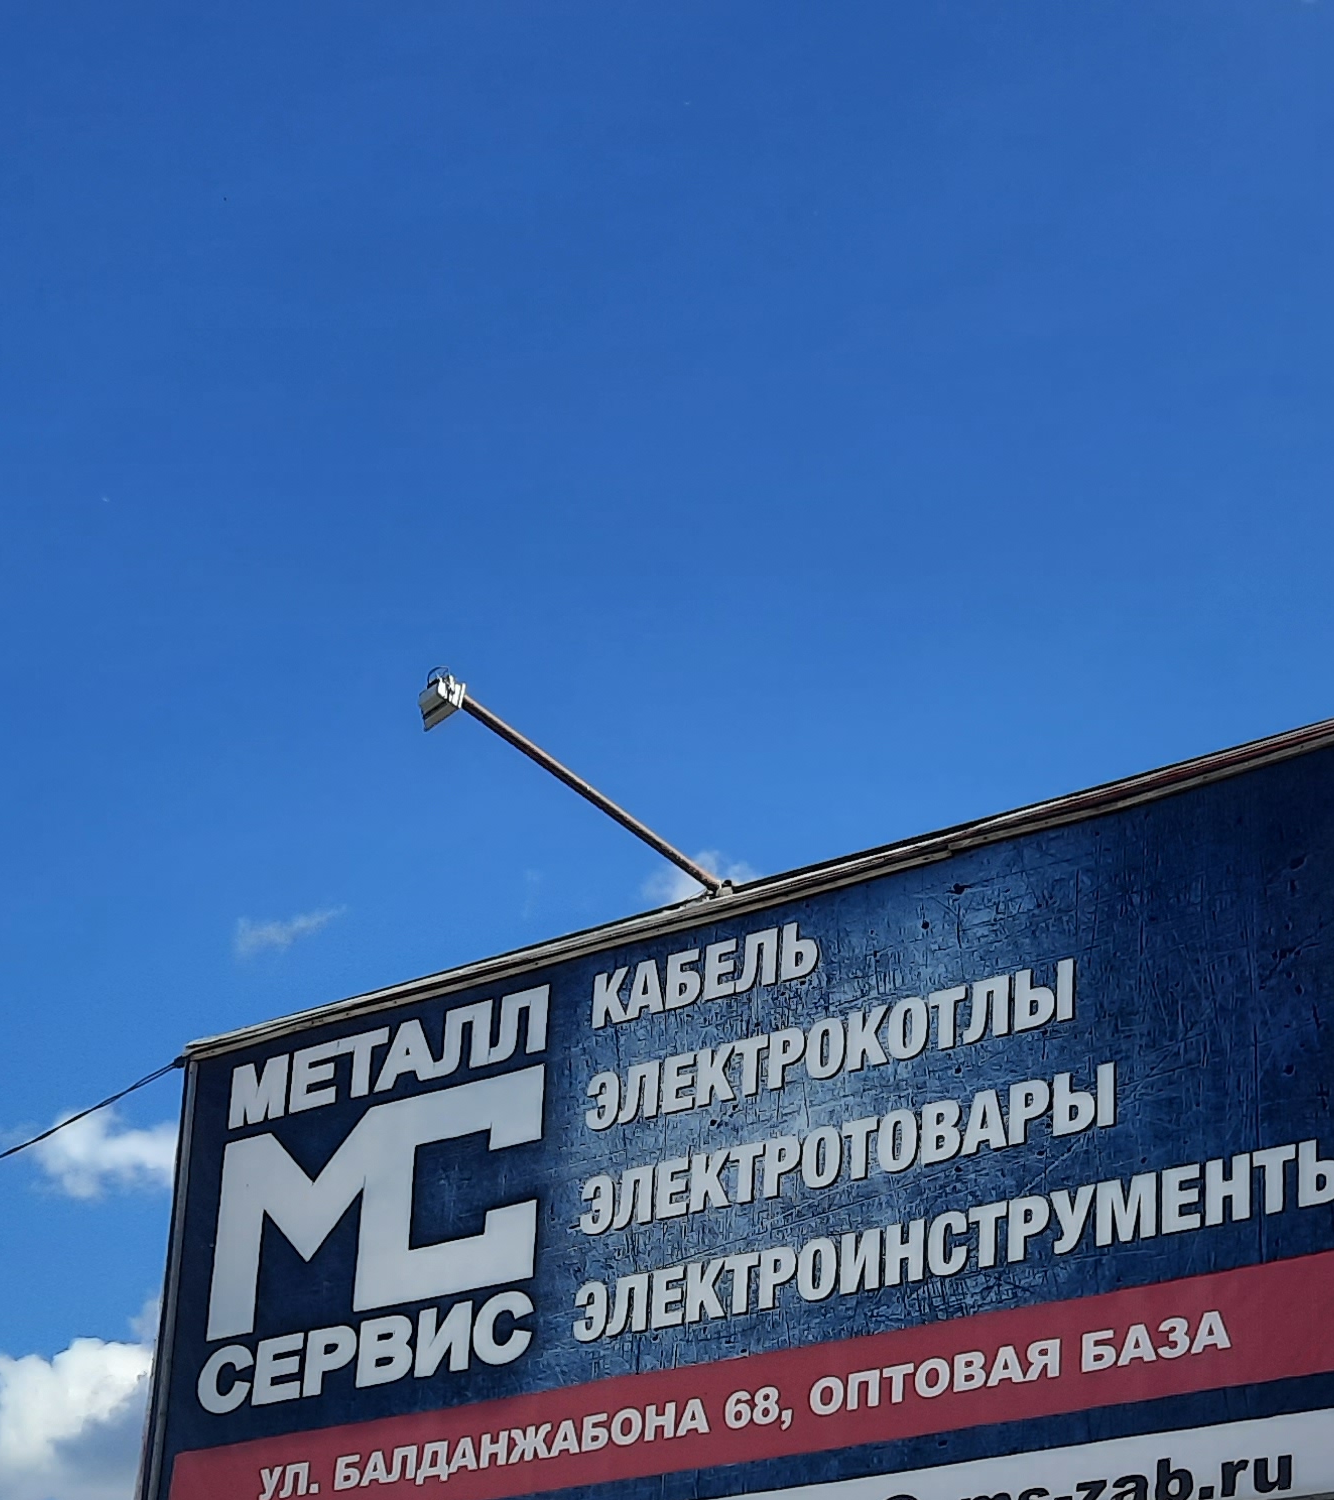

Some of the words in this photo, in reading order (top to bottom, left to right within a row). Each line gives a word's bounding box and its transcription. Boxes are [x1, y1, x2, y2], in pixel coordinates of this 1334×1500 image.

[228, 985, 551, 1129] МЕТАЛЛ
[586, 960, 1076, 1132] ЭЛЕКТРОКОТЛЫ
[592, 922, 819, 1029] КАБЕЛЬ
[207, 1064, 545, 1341] МС
[580, 1063, 1117, 1235] ЭЛЕКТРОТОВАРЫ
[197, 1291, 534, 1414] СЕРВИС
[334, 1396, 709, 1492] БАЛДАНЖАБОНА
[725, 1386, 793, 1431] 68,
[809, 1337, 1061, 1416] ОПТОВАЯ
[1081, 1311, 1232, 1374] БАЗА
